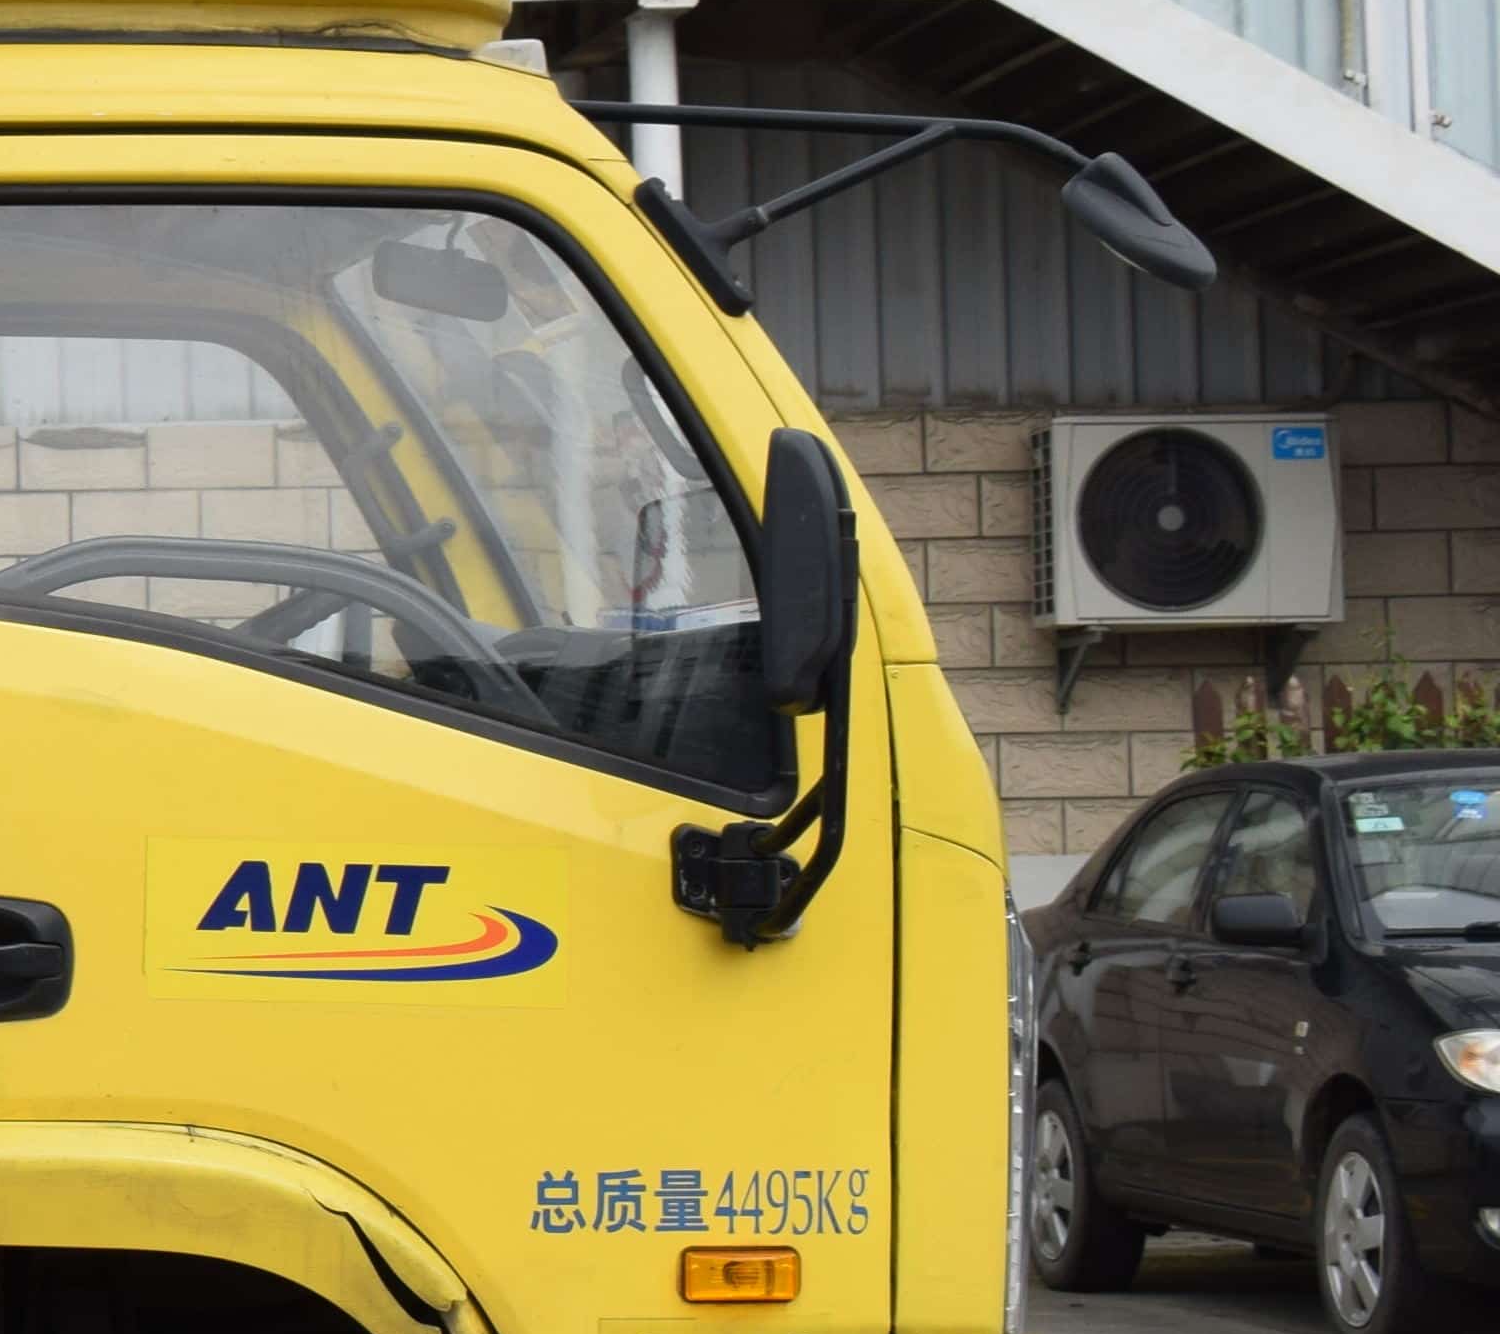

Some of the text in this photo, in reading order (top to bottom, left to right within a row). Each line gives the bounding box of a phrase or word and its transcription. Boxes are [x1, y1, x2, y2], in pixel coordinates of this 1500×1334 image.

[196, 860, 451, 935] ANT
[530, 1168, 871, 1235] 总质量4495Kg
